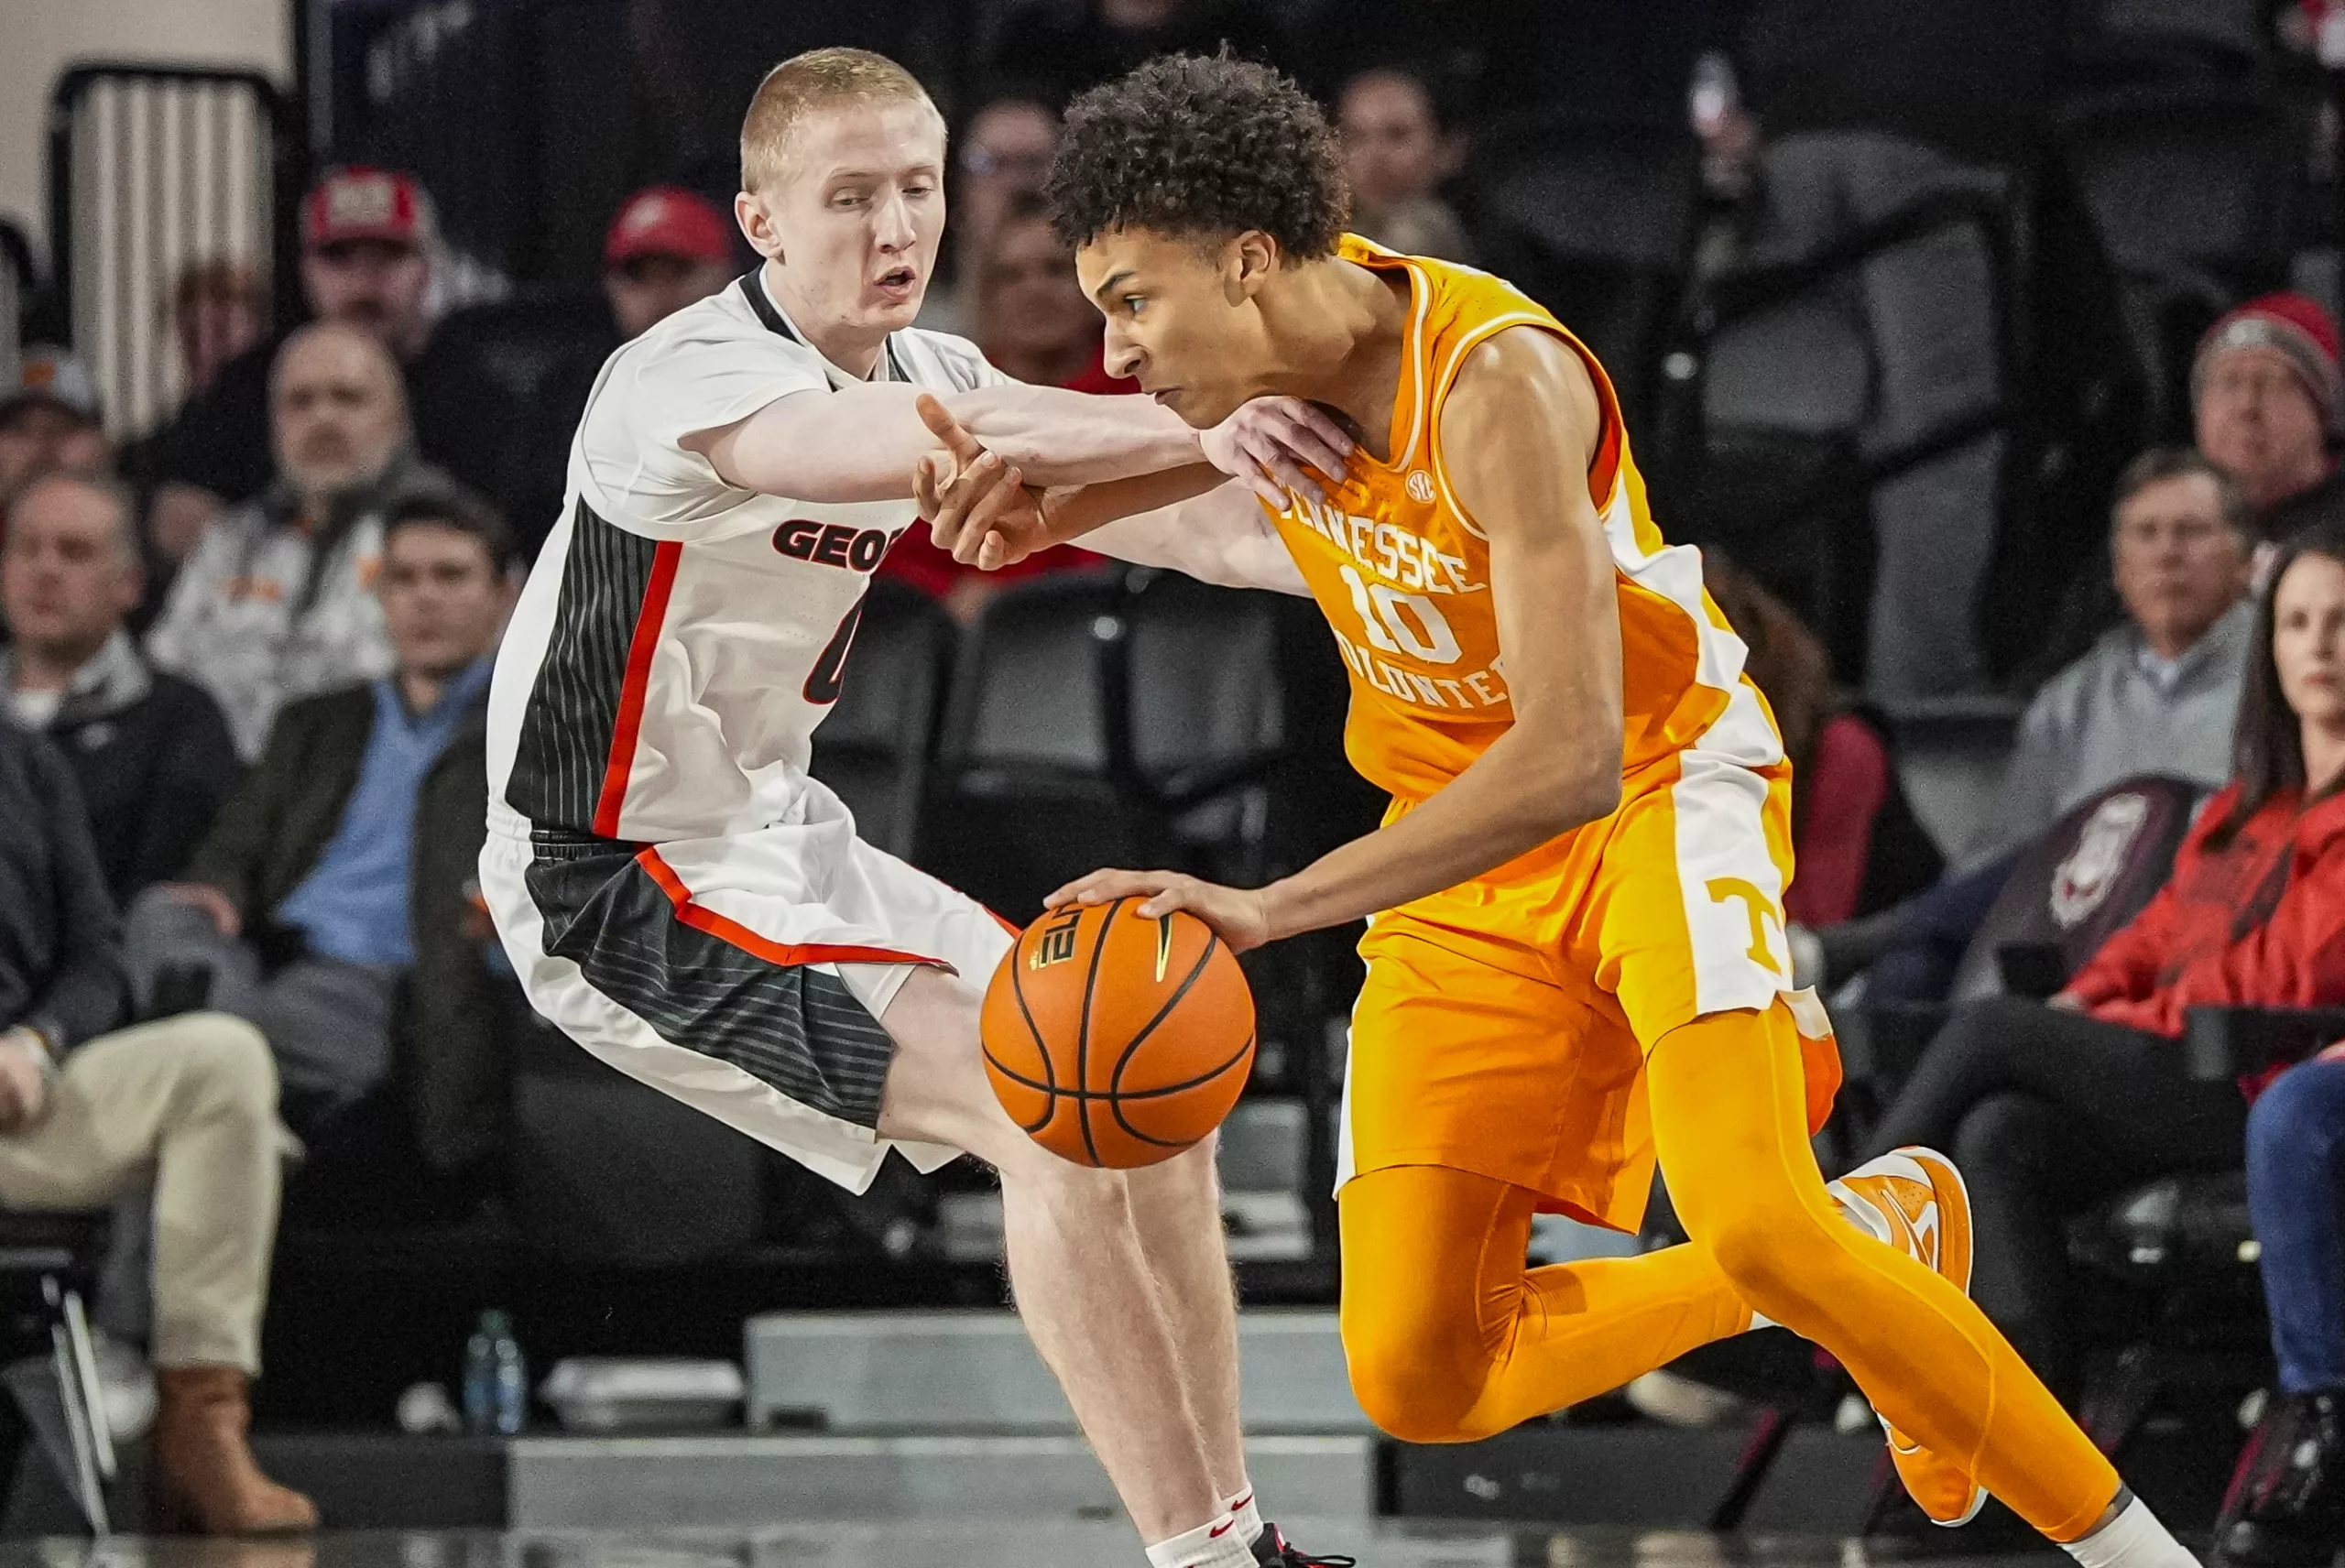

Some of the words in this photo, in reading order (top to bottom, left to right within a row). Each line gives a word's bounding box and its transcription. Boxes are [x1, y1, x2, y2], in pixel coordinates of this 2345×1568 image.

[772, 518, 905, 572] GEO
[1281, 484, 1487, 595] ENNESSEE
[1338, 563, 1464, 664] 10
[1704, 877, 1782, 977] T
